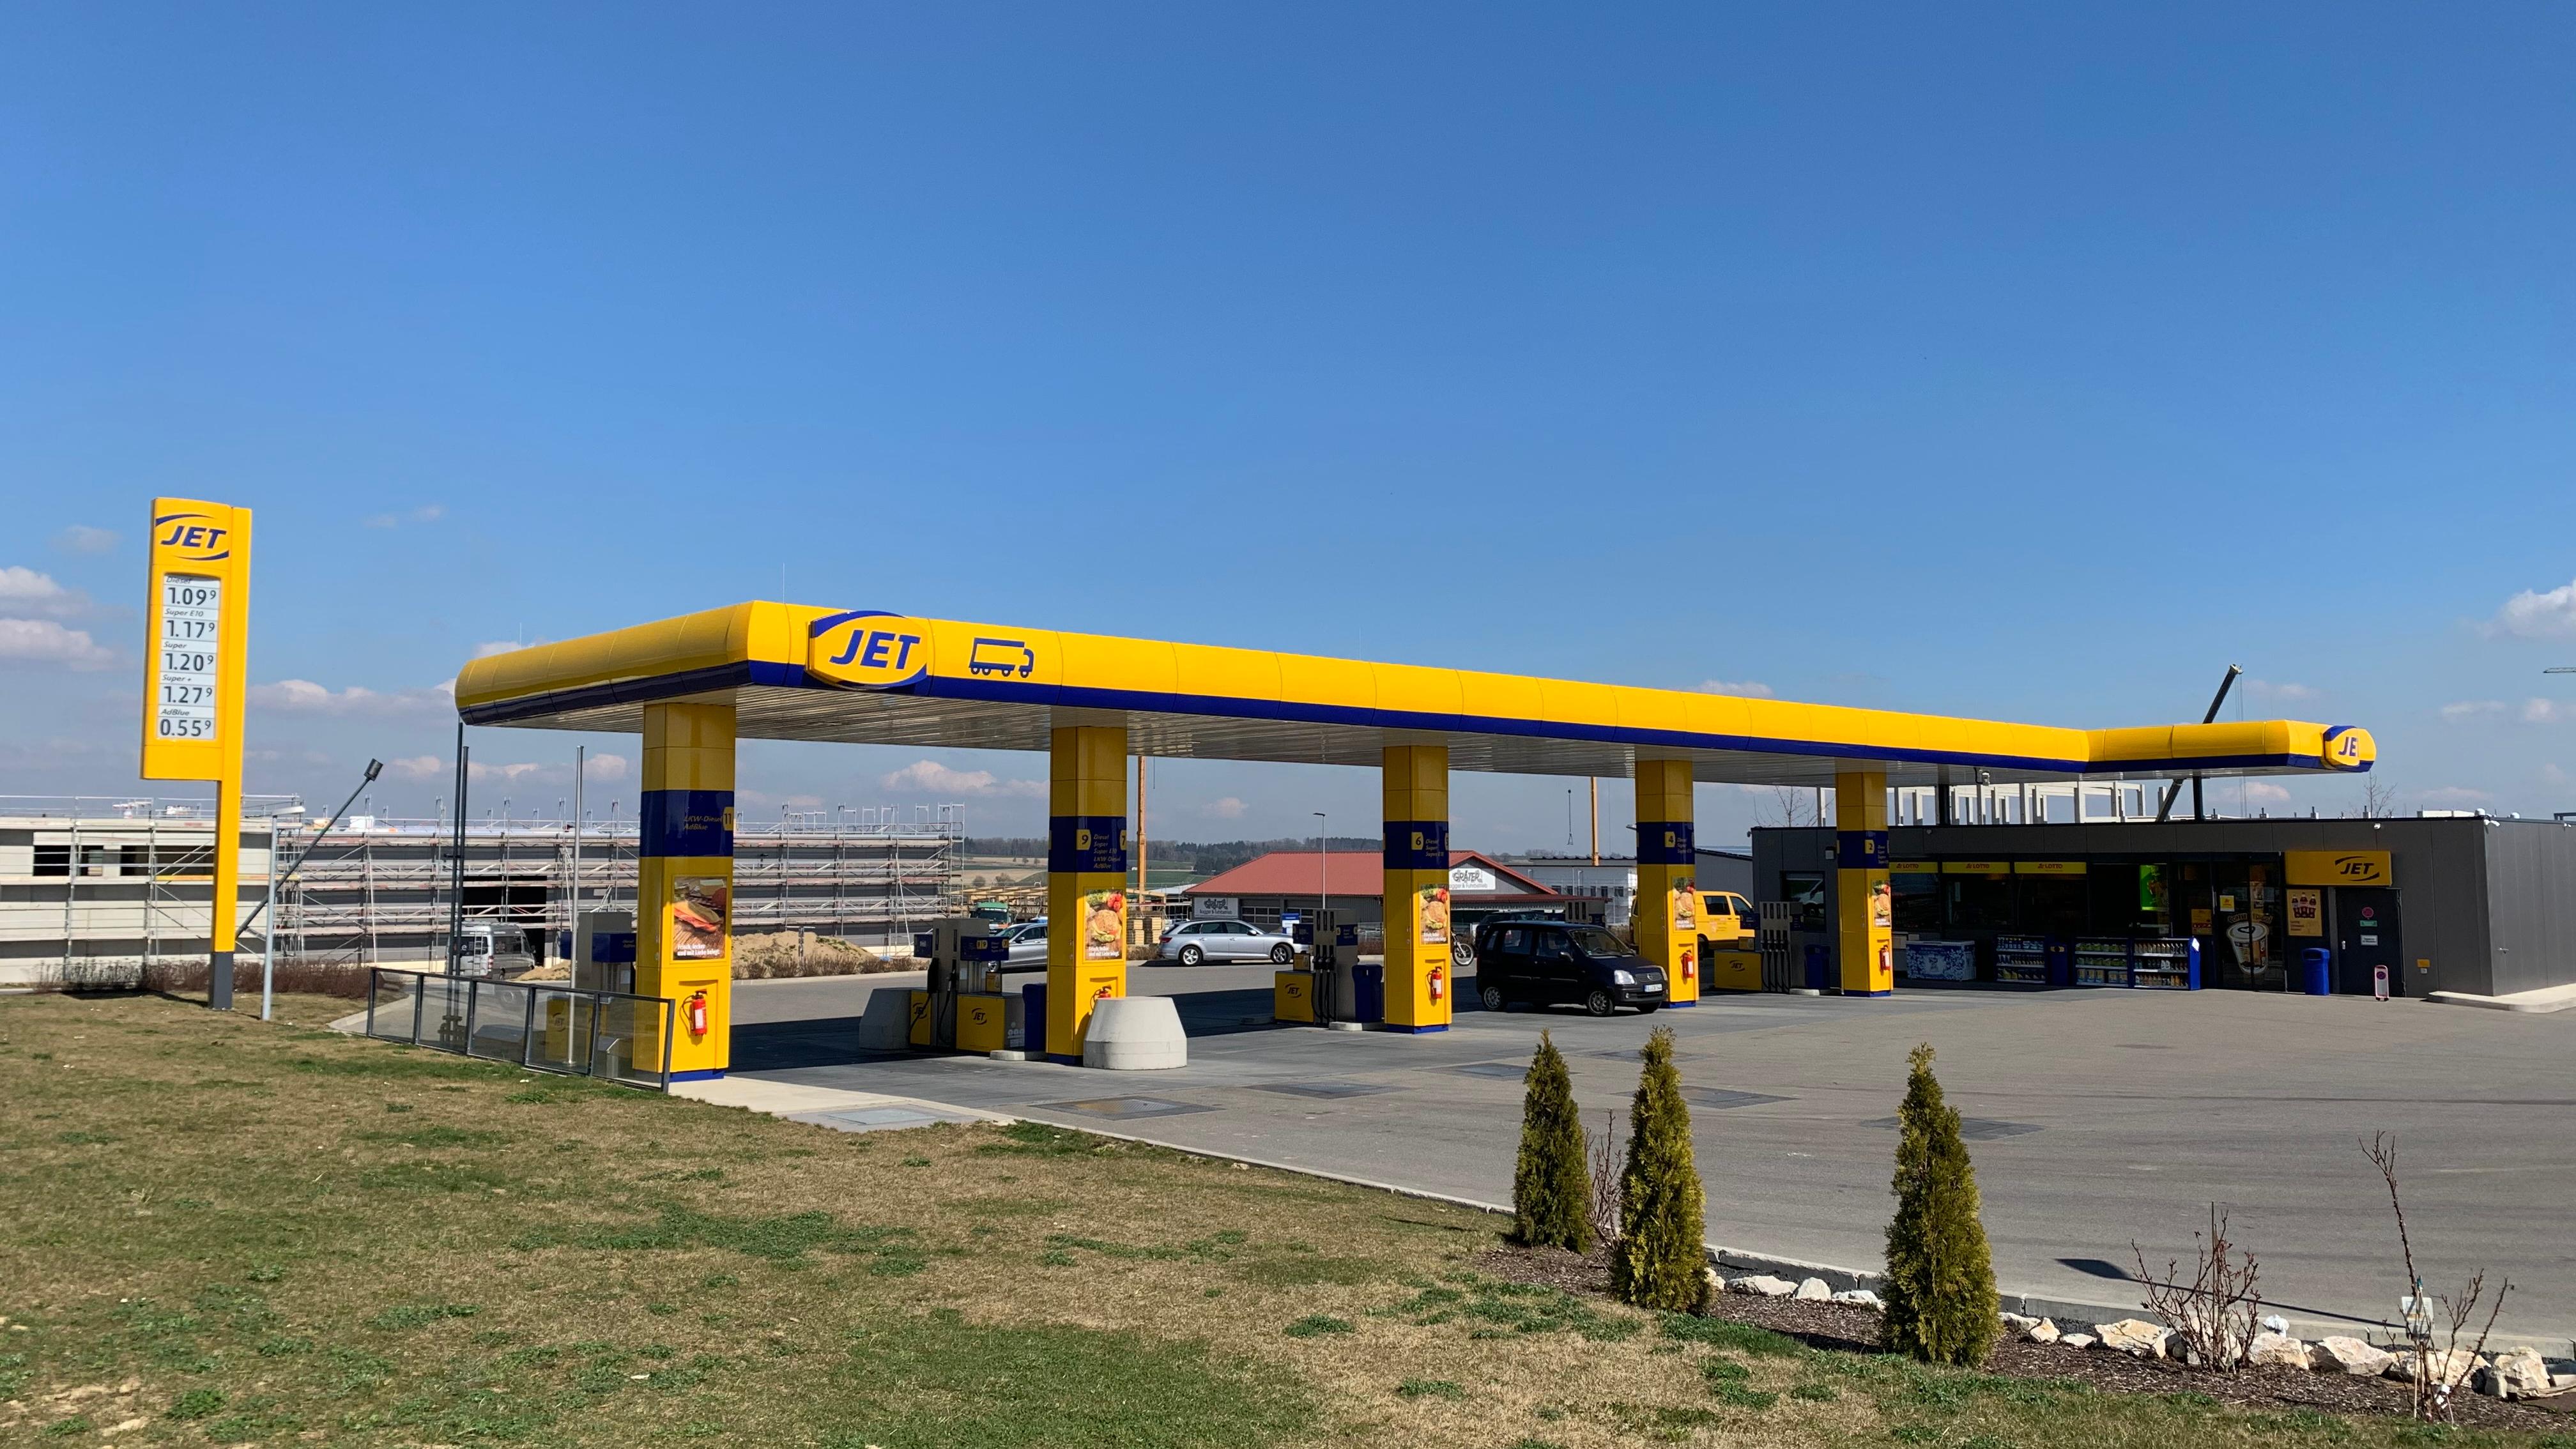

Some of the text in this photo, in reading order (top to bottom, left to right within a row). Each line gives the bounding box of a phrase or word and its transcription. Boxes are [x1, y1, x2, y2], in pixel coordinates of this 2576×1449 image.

[161, 526, 227, 549] JET
[165, 608, 188, 617] Super
[164, 641, 187, 650] Super
[829, 629, 921, 670] JET
[162, 674, 185, 683] Super
[2338, 737, 2357, 756] JE
[724, 813, 732, 825] 11
[1081, 834, 1089, 845] 9
[1415, 836, 1422, 846] 6
[1668, 835, 1674, 843] 4
[2340, 862, 2374, 875] JET
[973, 1012, 986, 1021] JET
